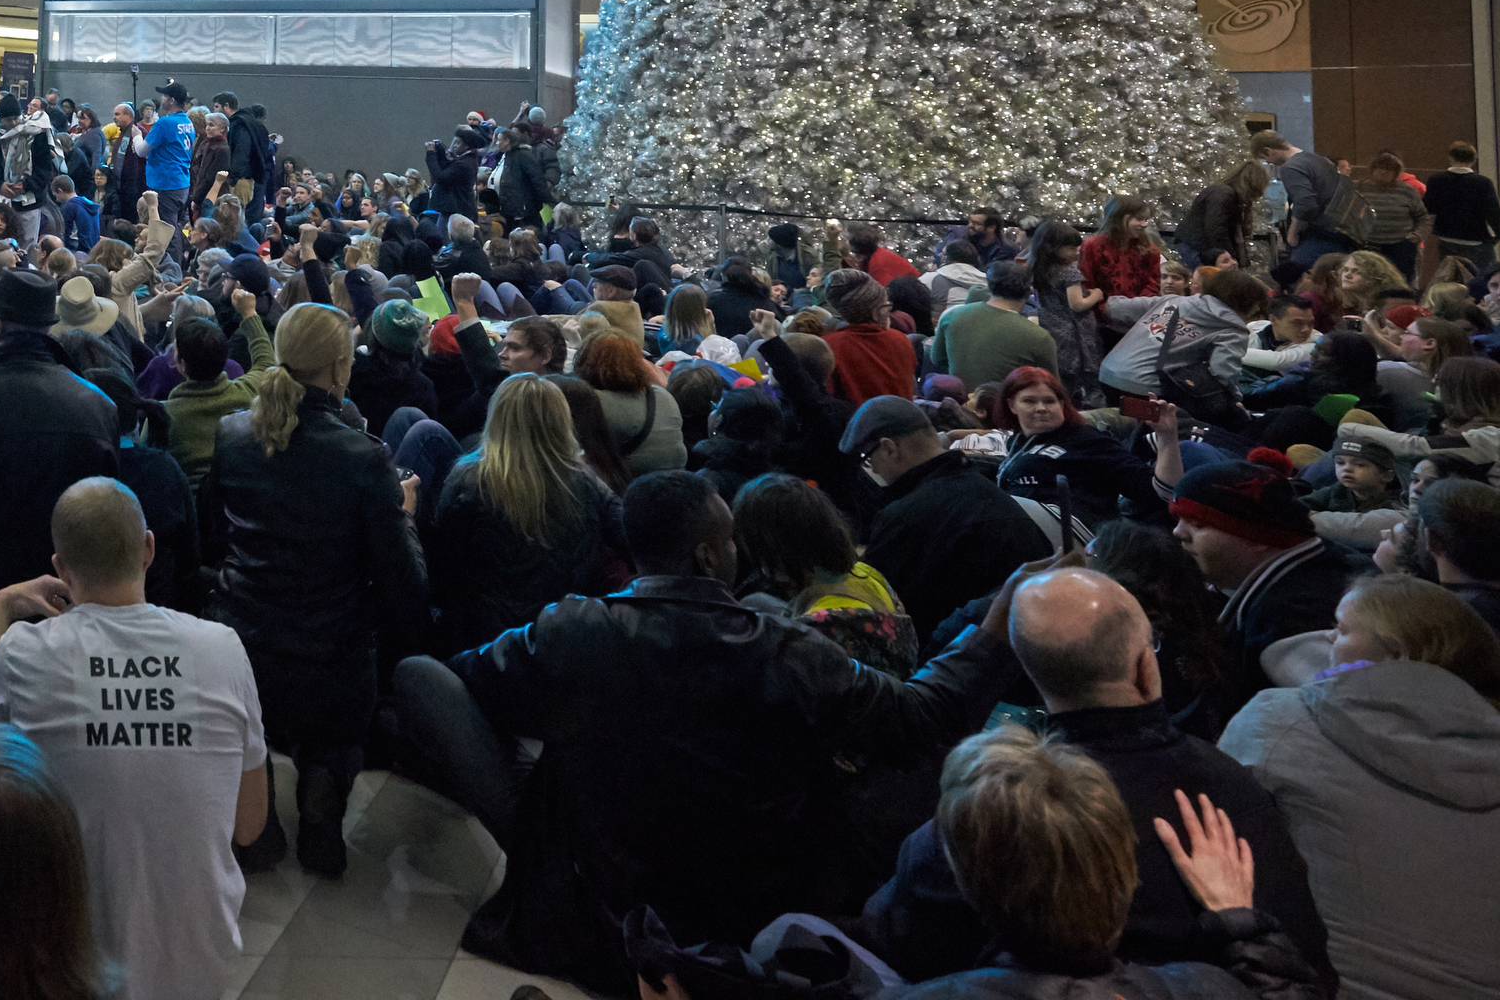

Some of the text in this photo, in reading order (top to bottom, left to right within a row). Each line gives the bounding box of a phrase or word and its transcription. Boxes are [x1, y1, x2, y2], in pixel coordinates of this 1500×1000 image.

[89, 655, 182, 678] BLACK
[101, 687, 175, 711] LIVES
[86, 722, 193, 747] MATTER
